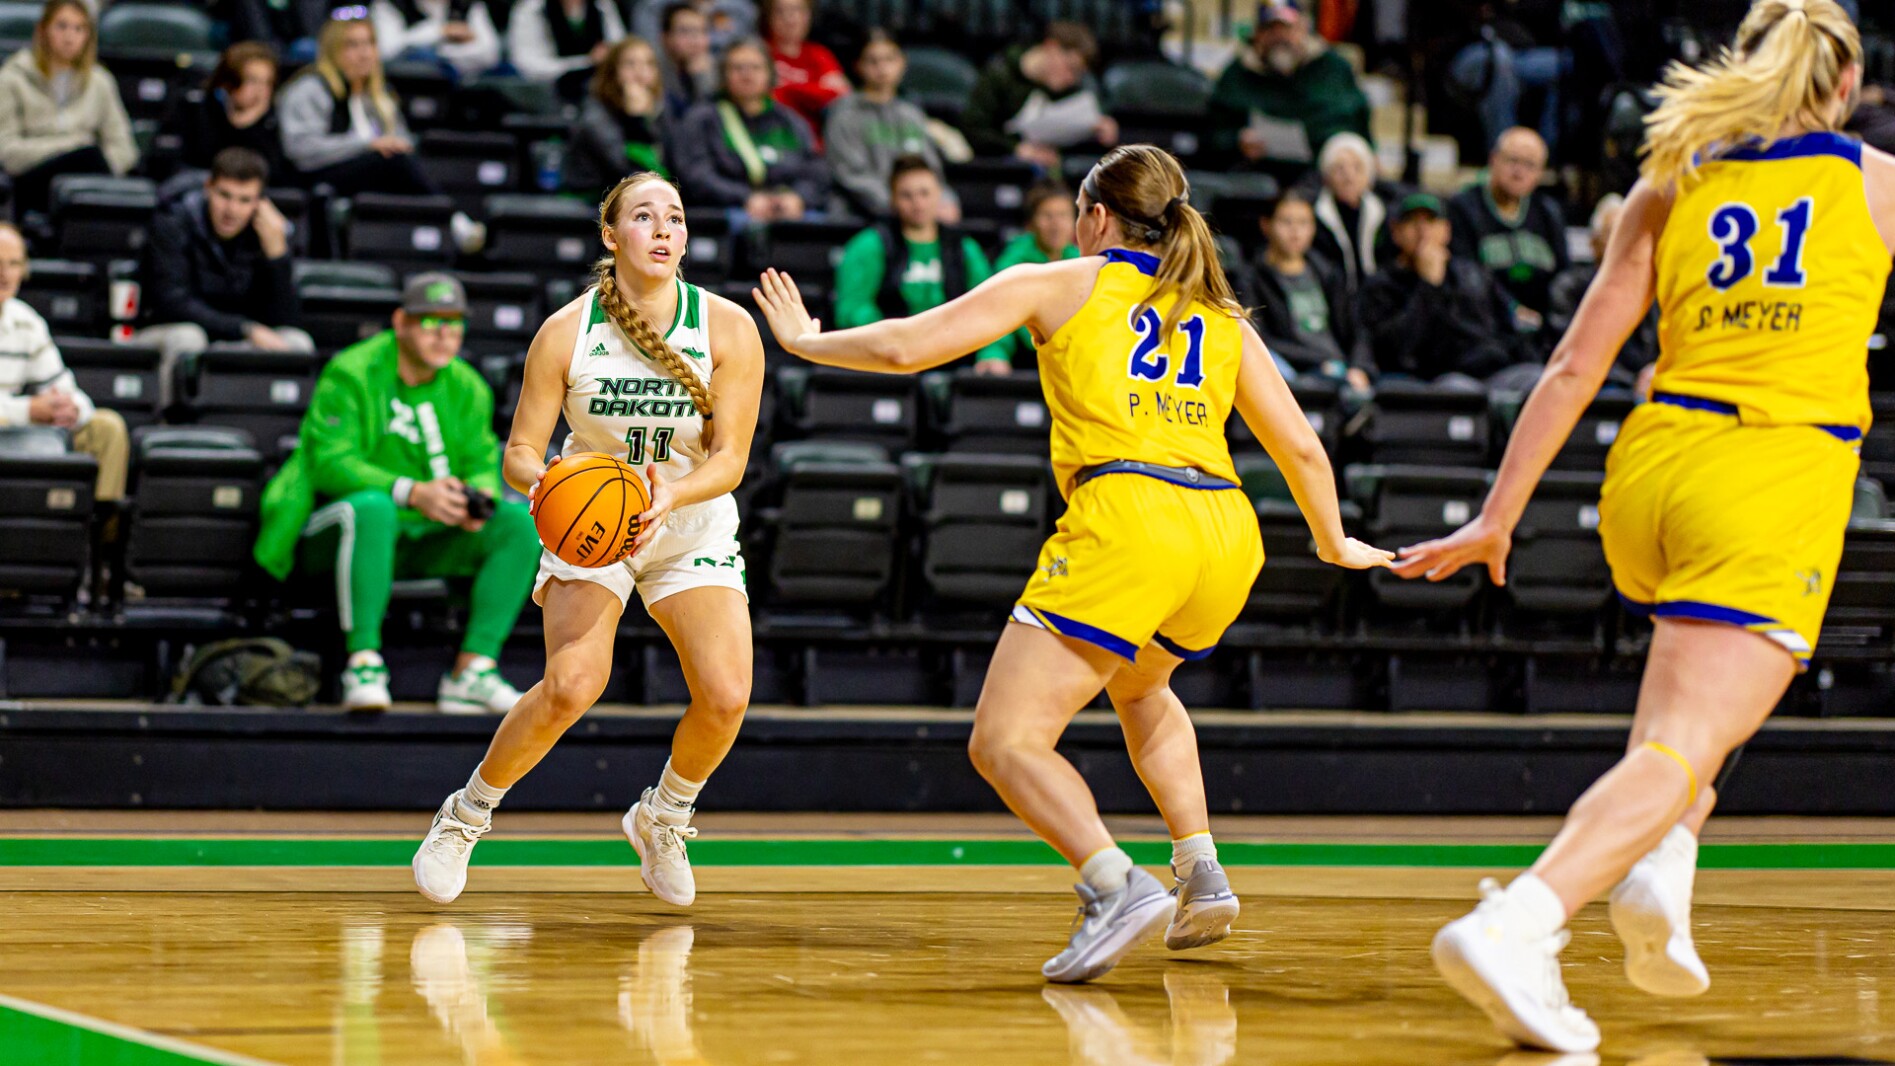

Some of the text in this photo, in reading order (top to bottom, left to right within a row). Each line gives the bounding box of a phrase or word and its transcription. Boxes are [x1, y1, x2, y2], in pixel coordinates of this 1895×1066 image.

[1707, 196, 1814, 293] 31
[1722, 301, 1803, 332] MEYER
[1127, 303, 1206, 391] 21
[1129, 392, 1149, 418] P.
[625, 426, 675, 465] 11
[576, 521, 606, 559] EVO
